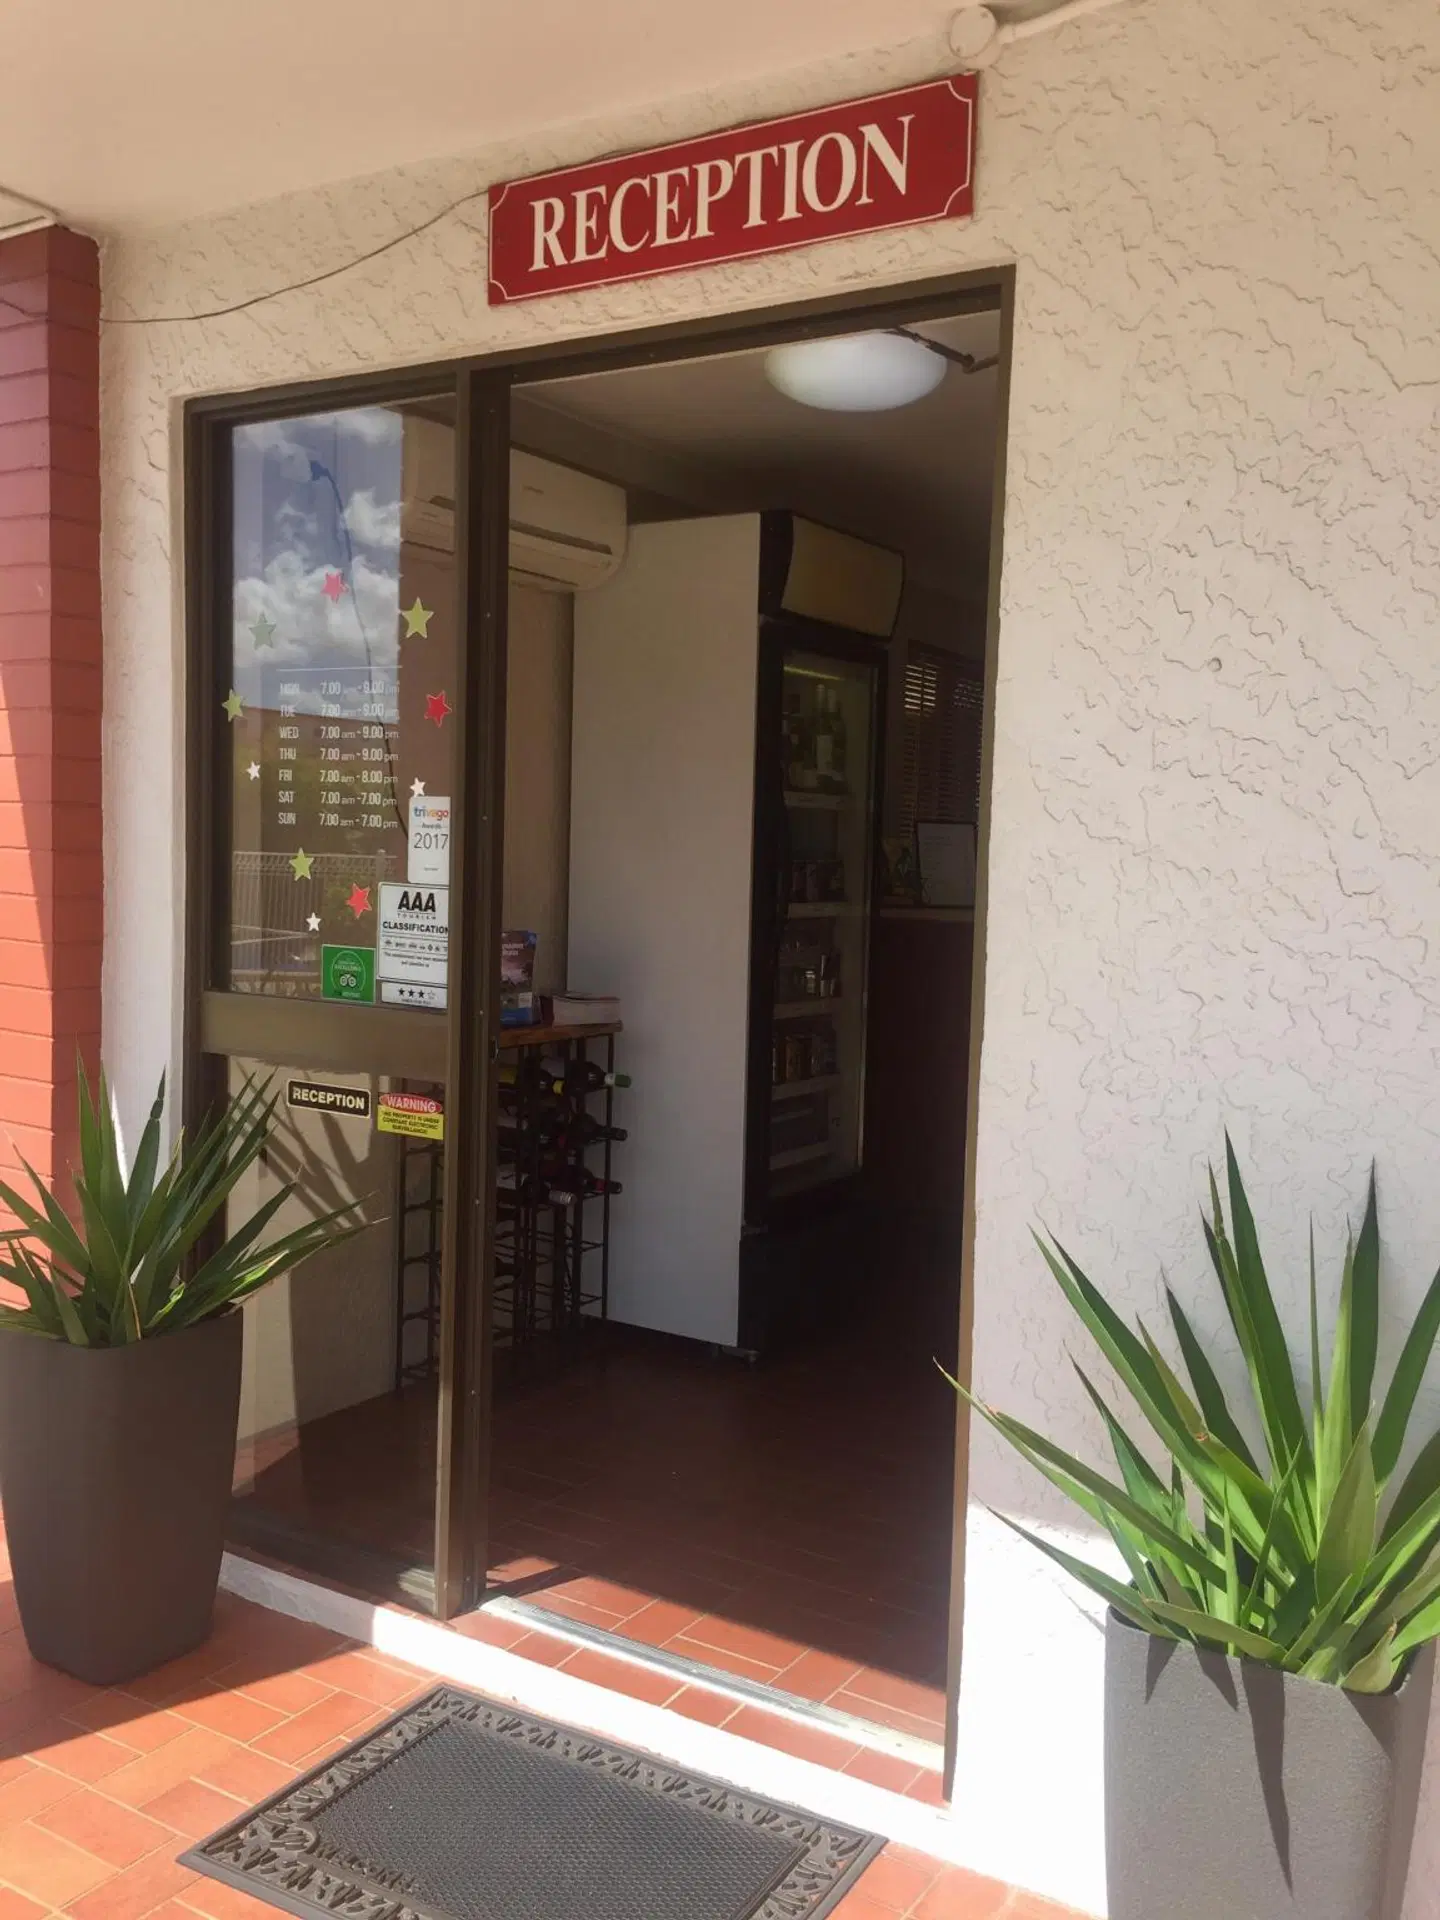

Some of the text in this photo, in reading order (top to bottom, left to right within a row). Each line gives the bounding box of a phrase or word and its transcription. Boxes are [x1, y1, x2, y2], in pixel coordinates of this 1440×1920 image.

[528, 114, 916, 273] RECEPTION
[320, 682, 341, 695] 7.00
[280, 726, 300, 739] WED
[320, 726, 341, 739] 7.00
[362, 726, 384, 739] 9.00
[279, 747, 297, 760] THU
[320, 747, 341, 760] 7.00
[362, 747, 383, 761] 9.00
[278, 769, 293, 782] FRI
[319, 769, 340, 782] 7.00
[361, 770, 383, 783] 8.00
[278, 790, 294, 803] SAT
[320, 791, 341, 804] 7.00
[382, 797, 398, 807] pm
[278, 812, 297, 825] SUN
[319, 813, 340, 826] 7.00
[361, 814, 383, 828] 7.00
[382, 820, 399, 829] pm
[414, 832, 449, 850] 2017
[397, 890, 436, 912] AAA
[292, 1087, 366, 1110] RECEPTION
[387, 1095, 437, 1113] WARNING
